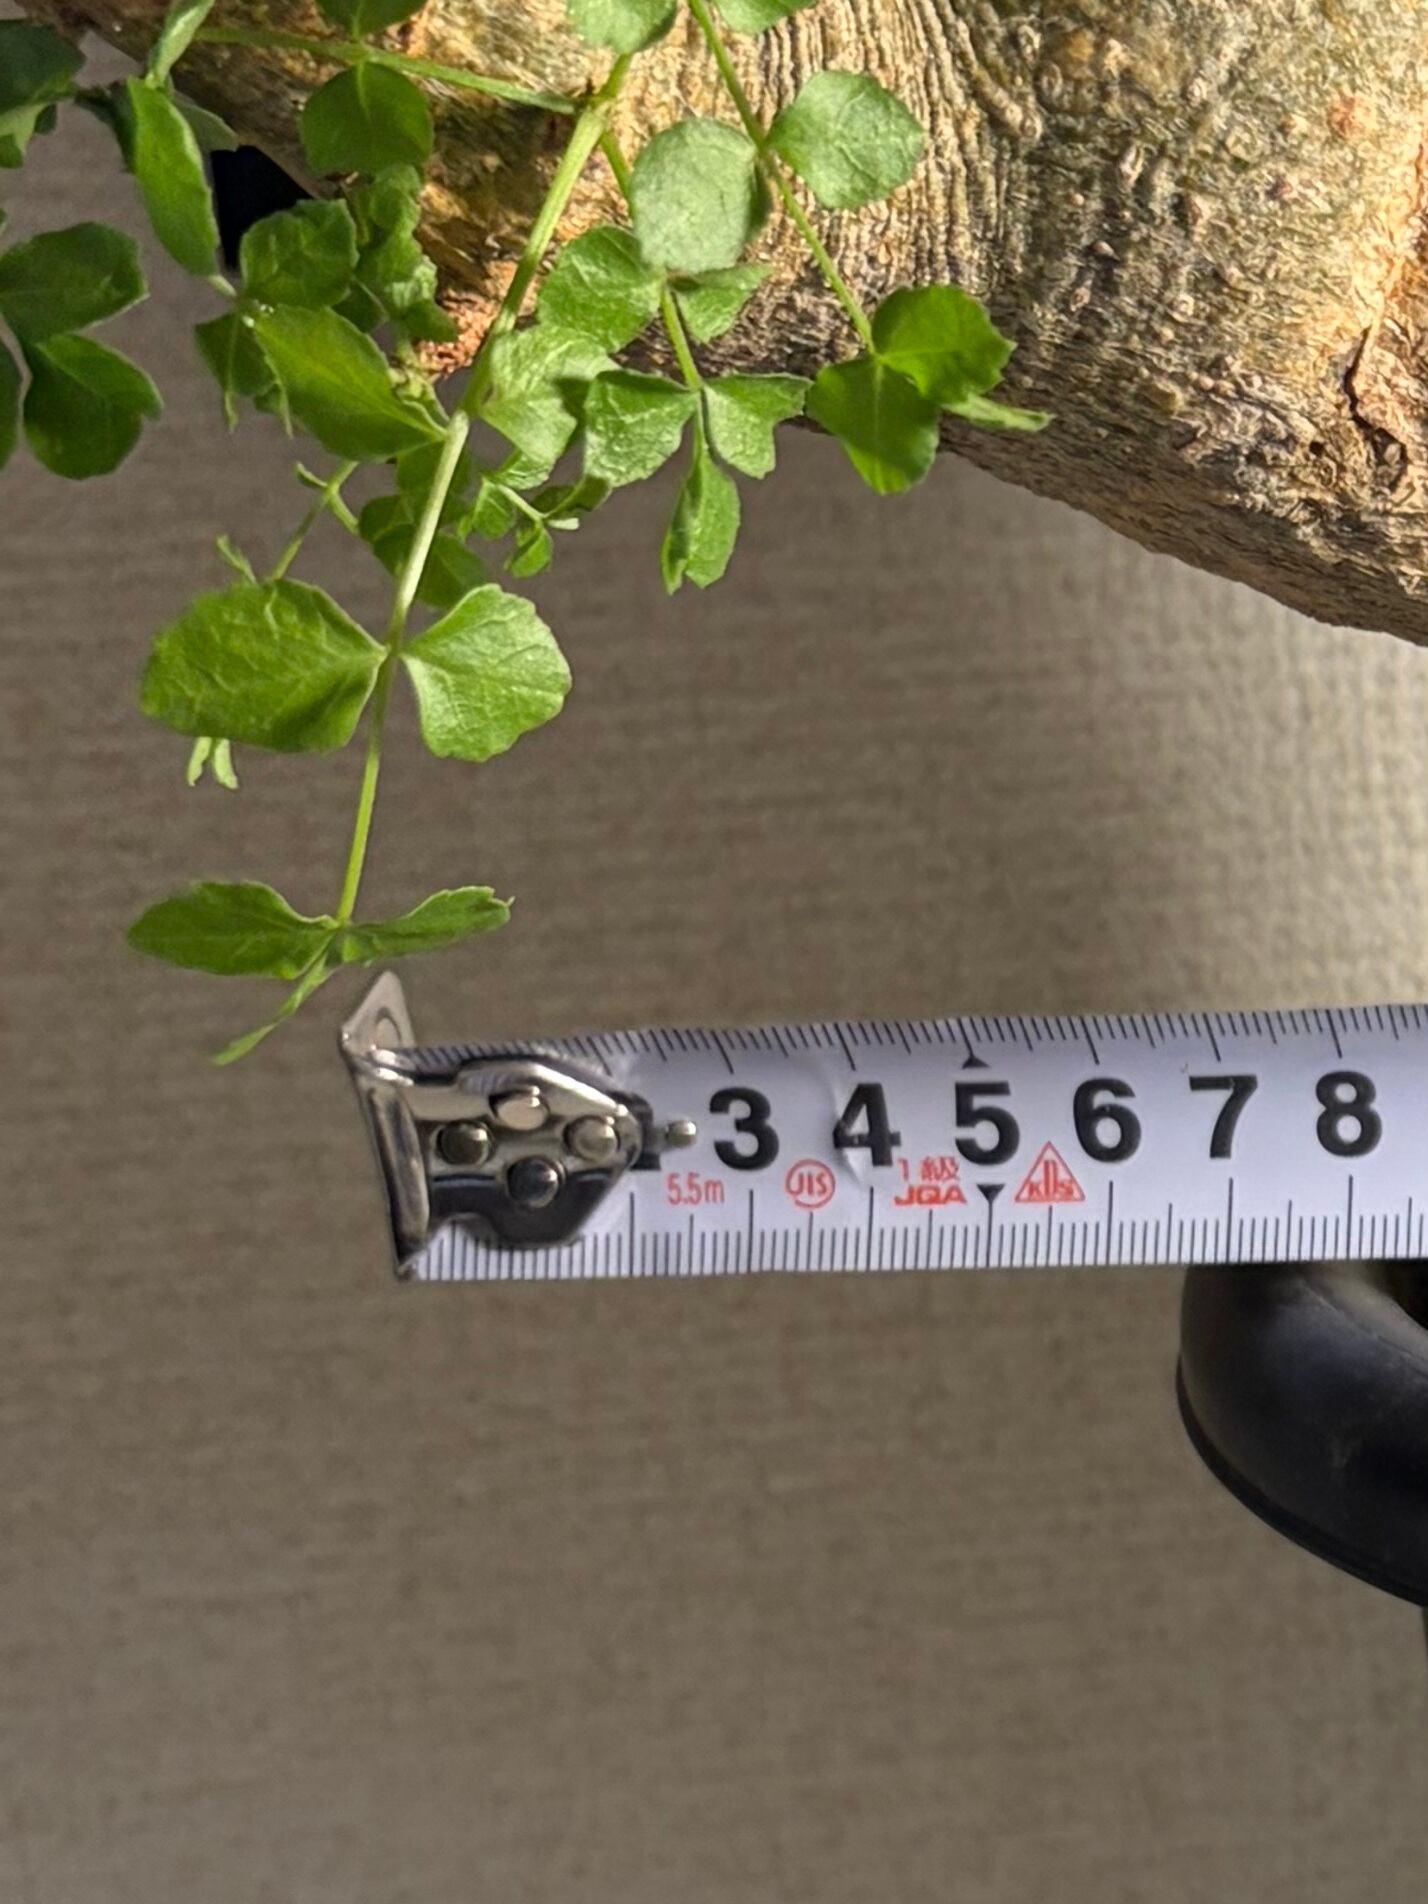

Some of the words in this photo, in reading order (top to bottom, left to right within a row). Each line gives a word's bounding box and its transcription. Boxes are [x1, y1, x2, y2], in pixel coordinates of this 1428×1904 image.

[709, 1087, 779, 1171] 3
[831, 1082, 901, 1167] 4
[955, 1080, 1020, 1165] 5
[1072, 1077, 1141, 1163] 6
[1188, 1074, 1258, 1159] 7
[1315, 1070, 1382, 1158] 8
[667, 1173, 724, 1206] 5.5m
[790, 1166, 832, 1202] JIS
[895, 1185, 967, 1205] JQA
